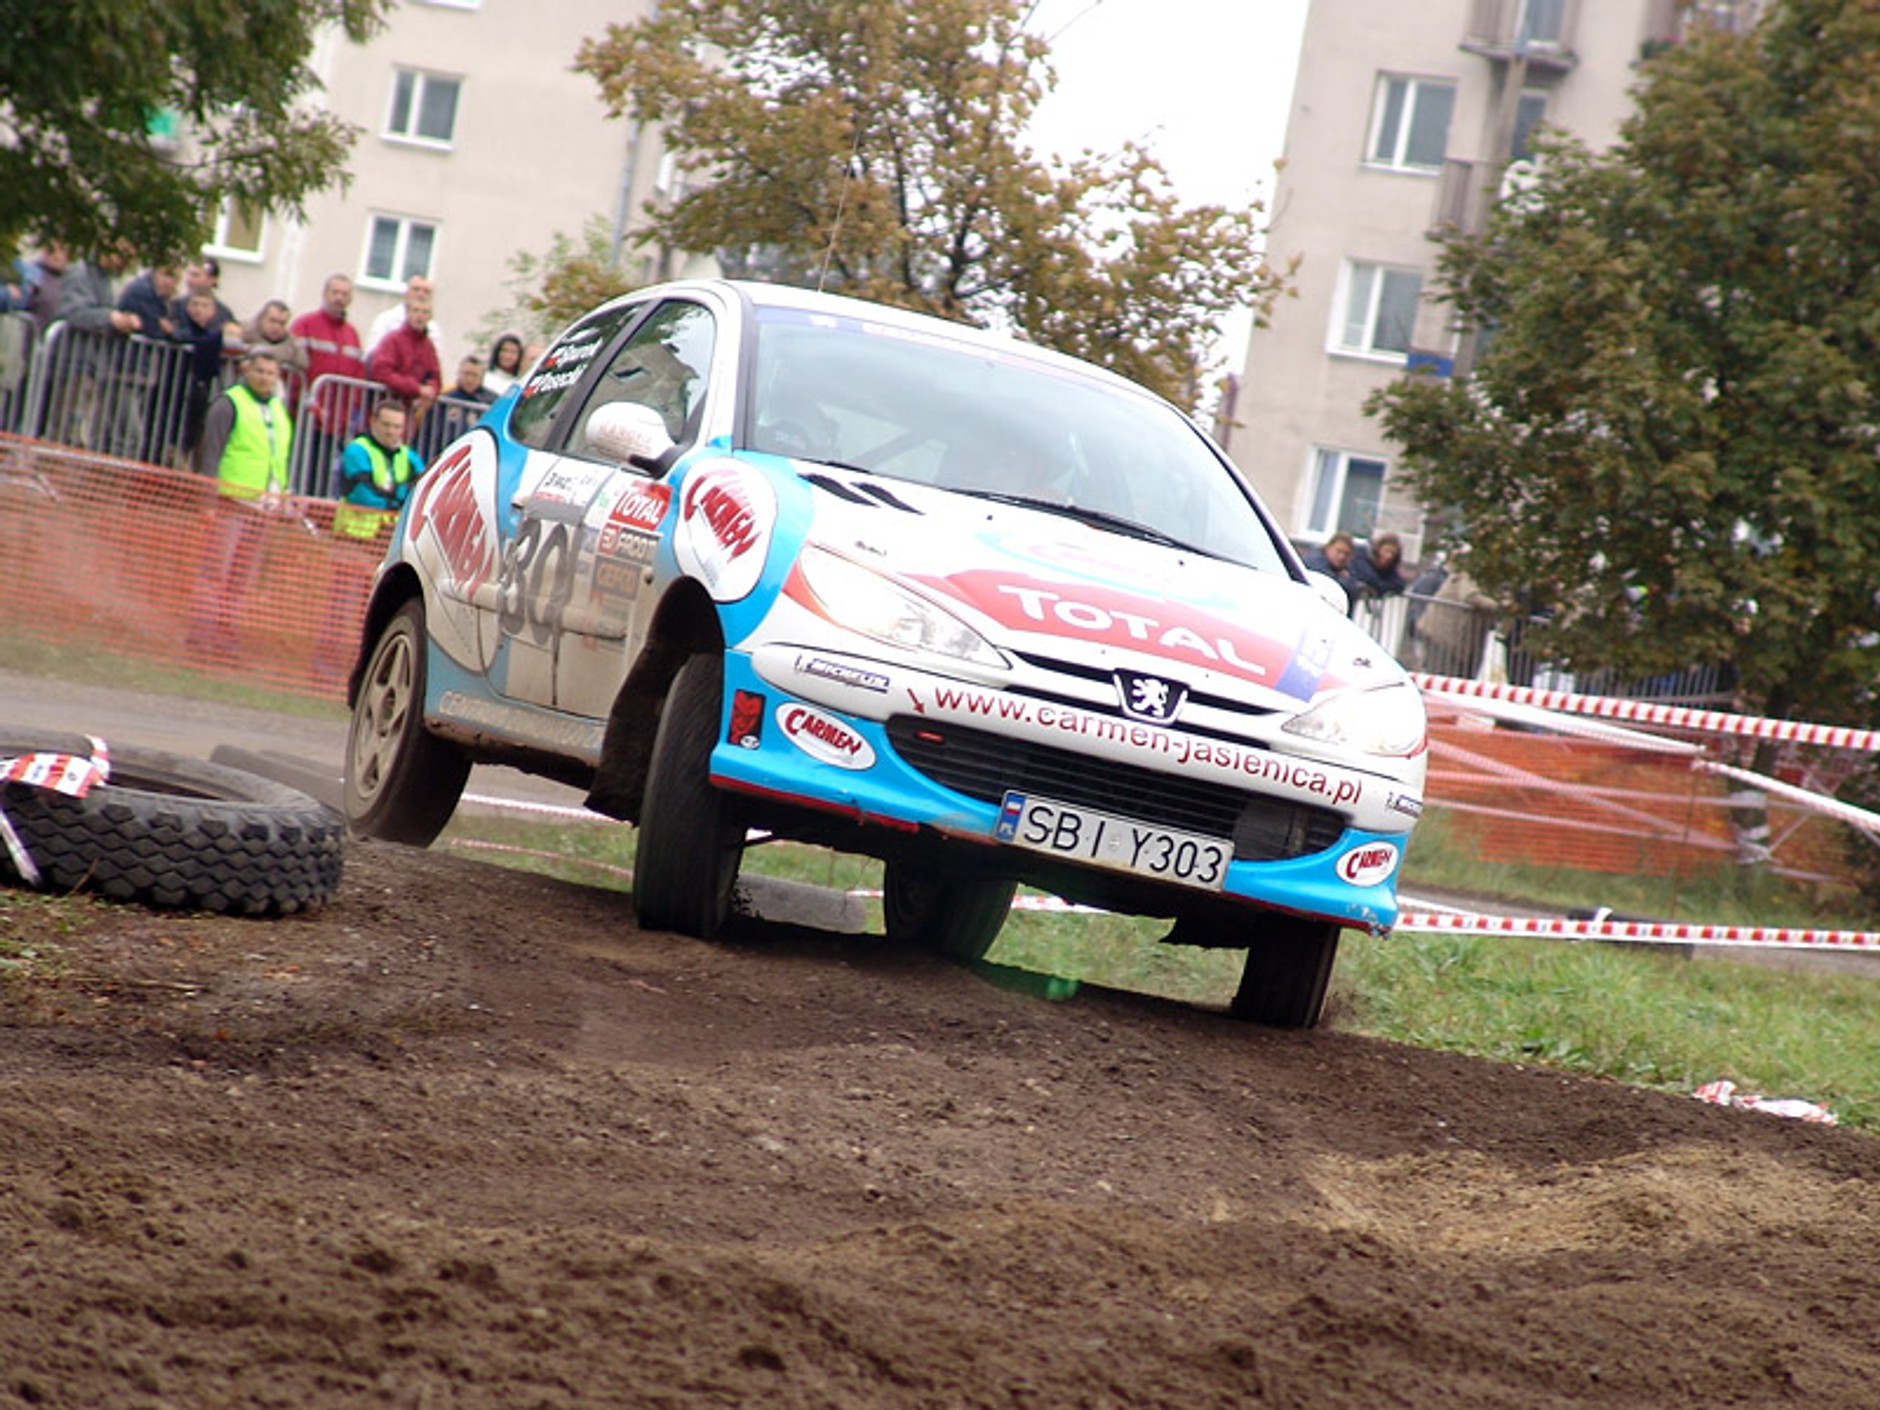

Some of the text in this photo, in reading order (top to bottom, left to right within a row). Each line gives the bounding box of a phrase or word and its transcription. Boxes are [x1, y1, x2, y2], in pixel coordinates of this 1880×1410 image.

[613, 487, 663, 524] TOTAL
[998, 584, 1266, 676] TOTAL
[785, 708, 863, 755] CARMEN
[936, 686, 1362, 804] www.carmen-jasienica.pl
[1346, 848, 1392, 879] CARMEN
